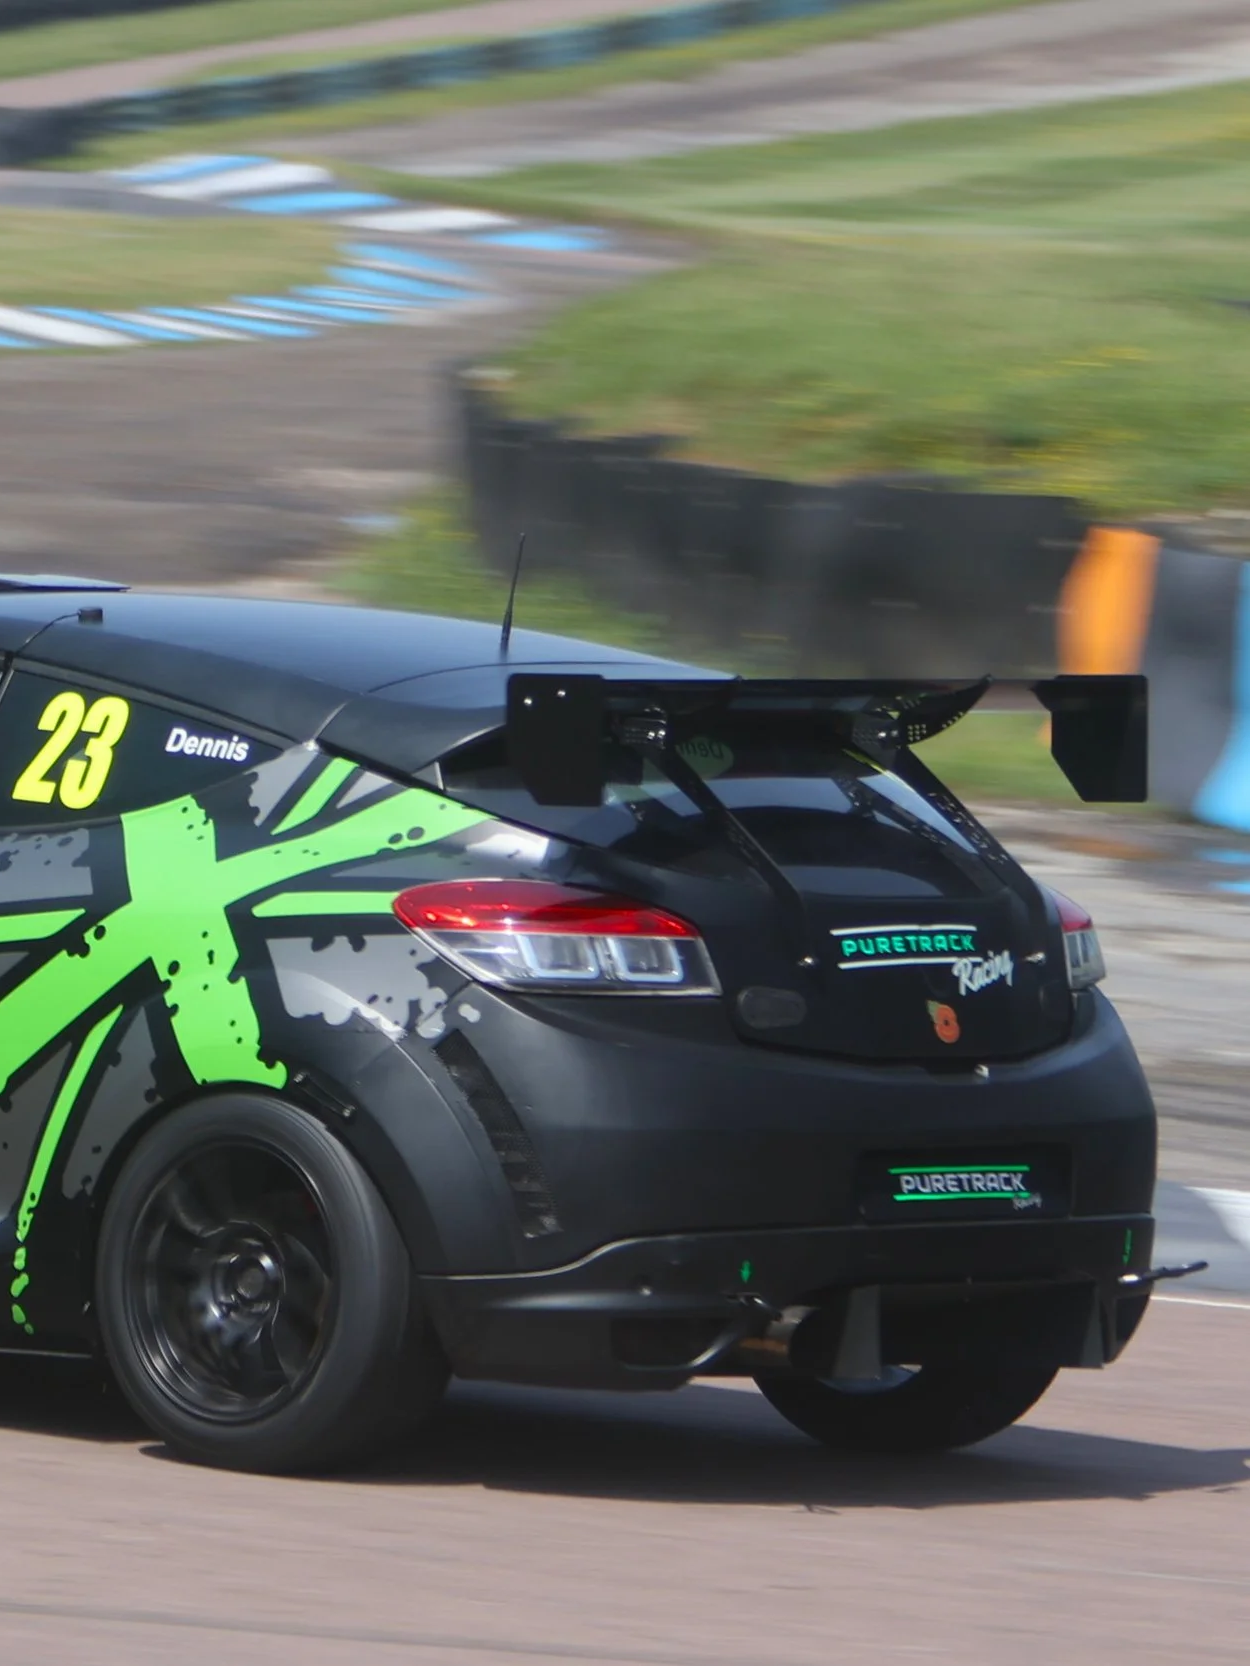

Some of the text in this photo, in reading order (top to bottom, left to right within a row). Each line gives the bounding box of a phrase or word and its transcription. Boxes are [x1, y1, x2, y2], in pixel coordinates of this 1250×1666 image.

[12, 691, 130, 810] 23
[164, 726, 250, 762] Dennis
[841, 934, 976, 957] PURETRACK
[951, 949, 1015, 996] Racing
[900, 1172, 1027, 1194] PURETRACK
